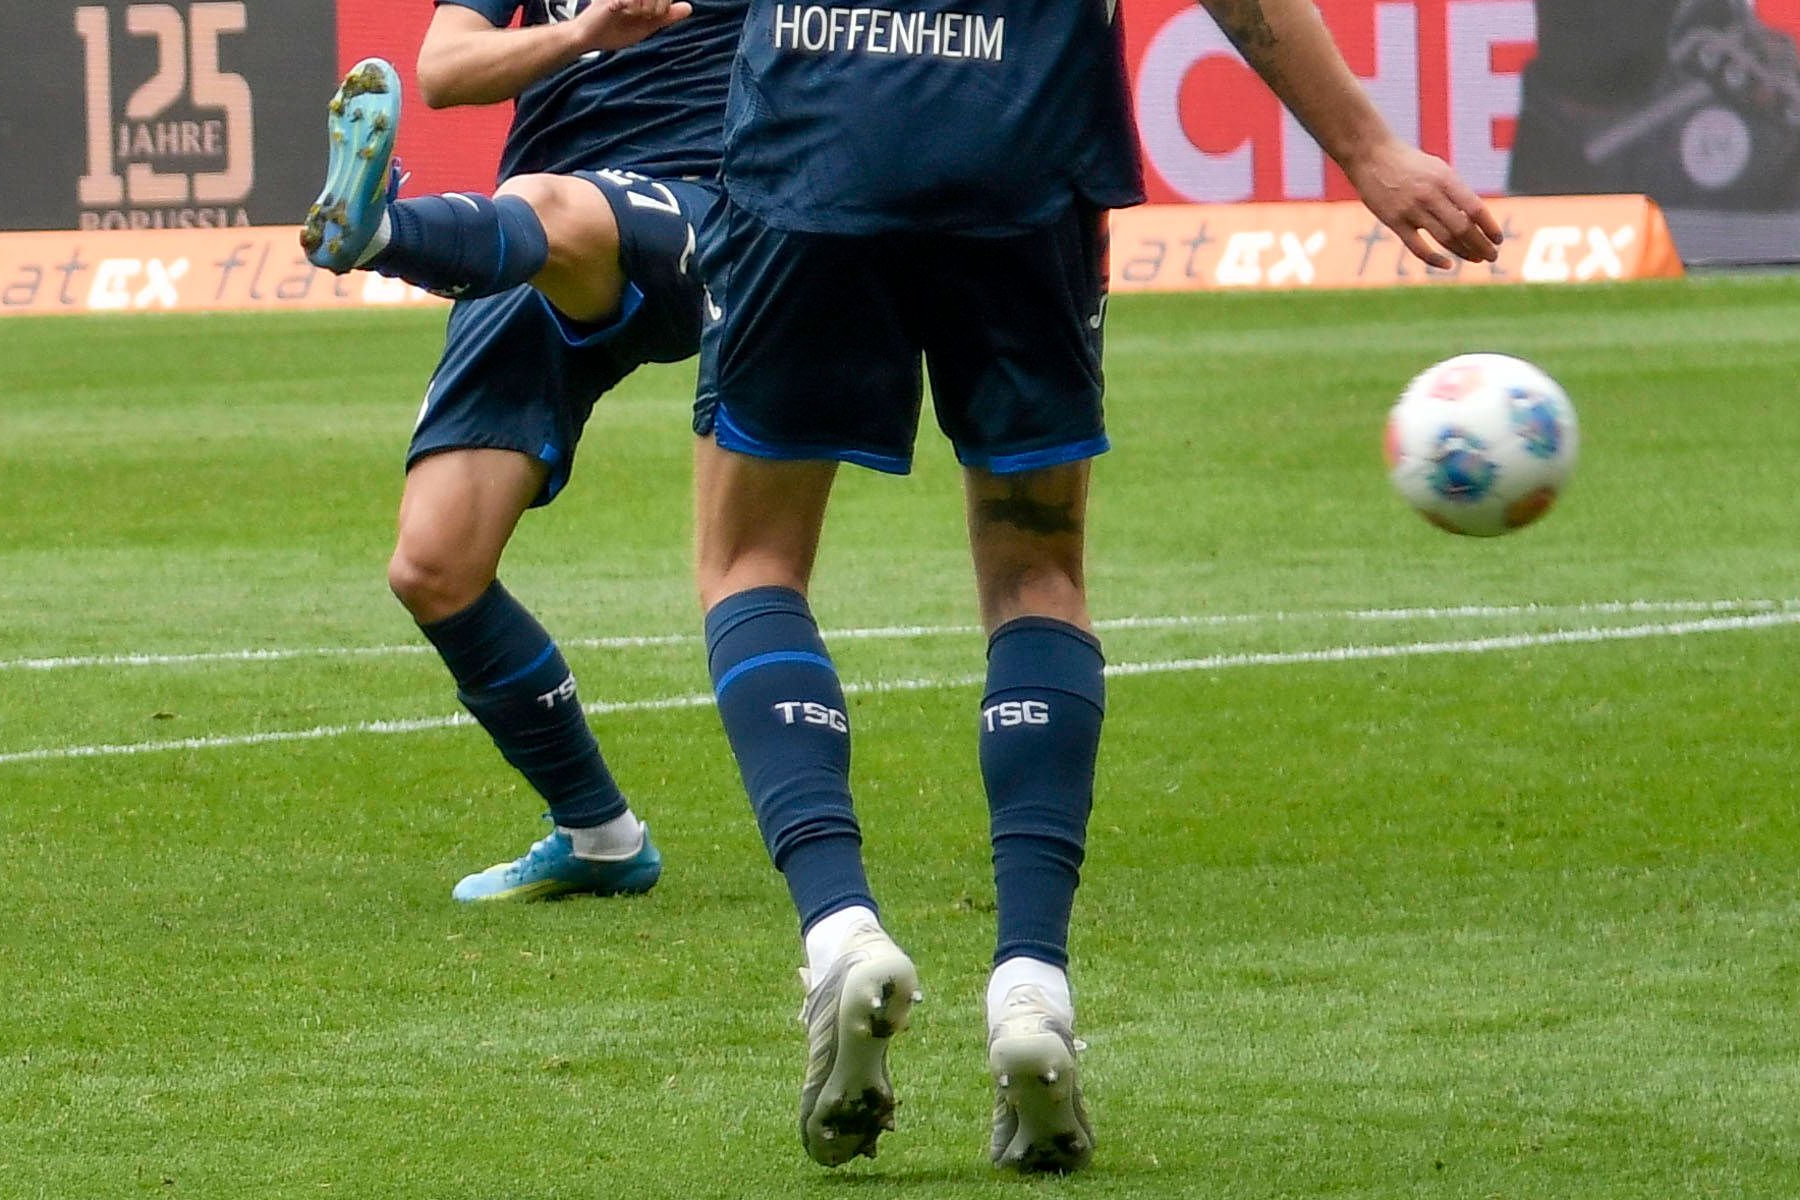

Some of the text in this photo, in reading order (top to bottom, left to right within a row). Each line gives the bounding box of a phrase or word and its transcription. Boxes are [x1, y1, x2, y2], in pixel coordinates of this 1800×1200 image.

[774, 5, 1005, 62] HOFFENHEIM
[75, 1, 255, 203] 125
[119, 120, 224, 156] JAHRE
[775, 701, 848, 733] TSG
[983, 700, 1050, 732] TSG
